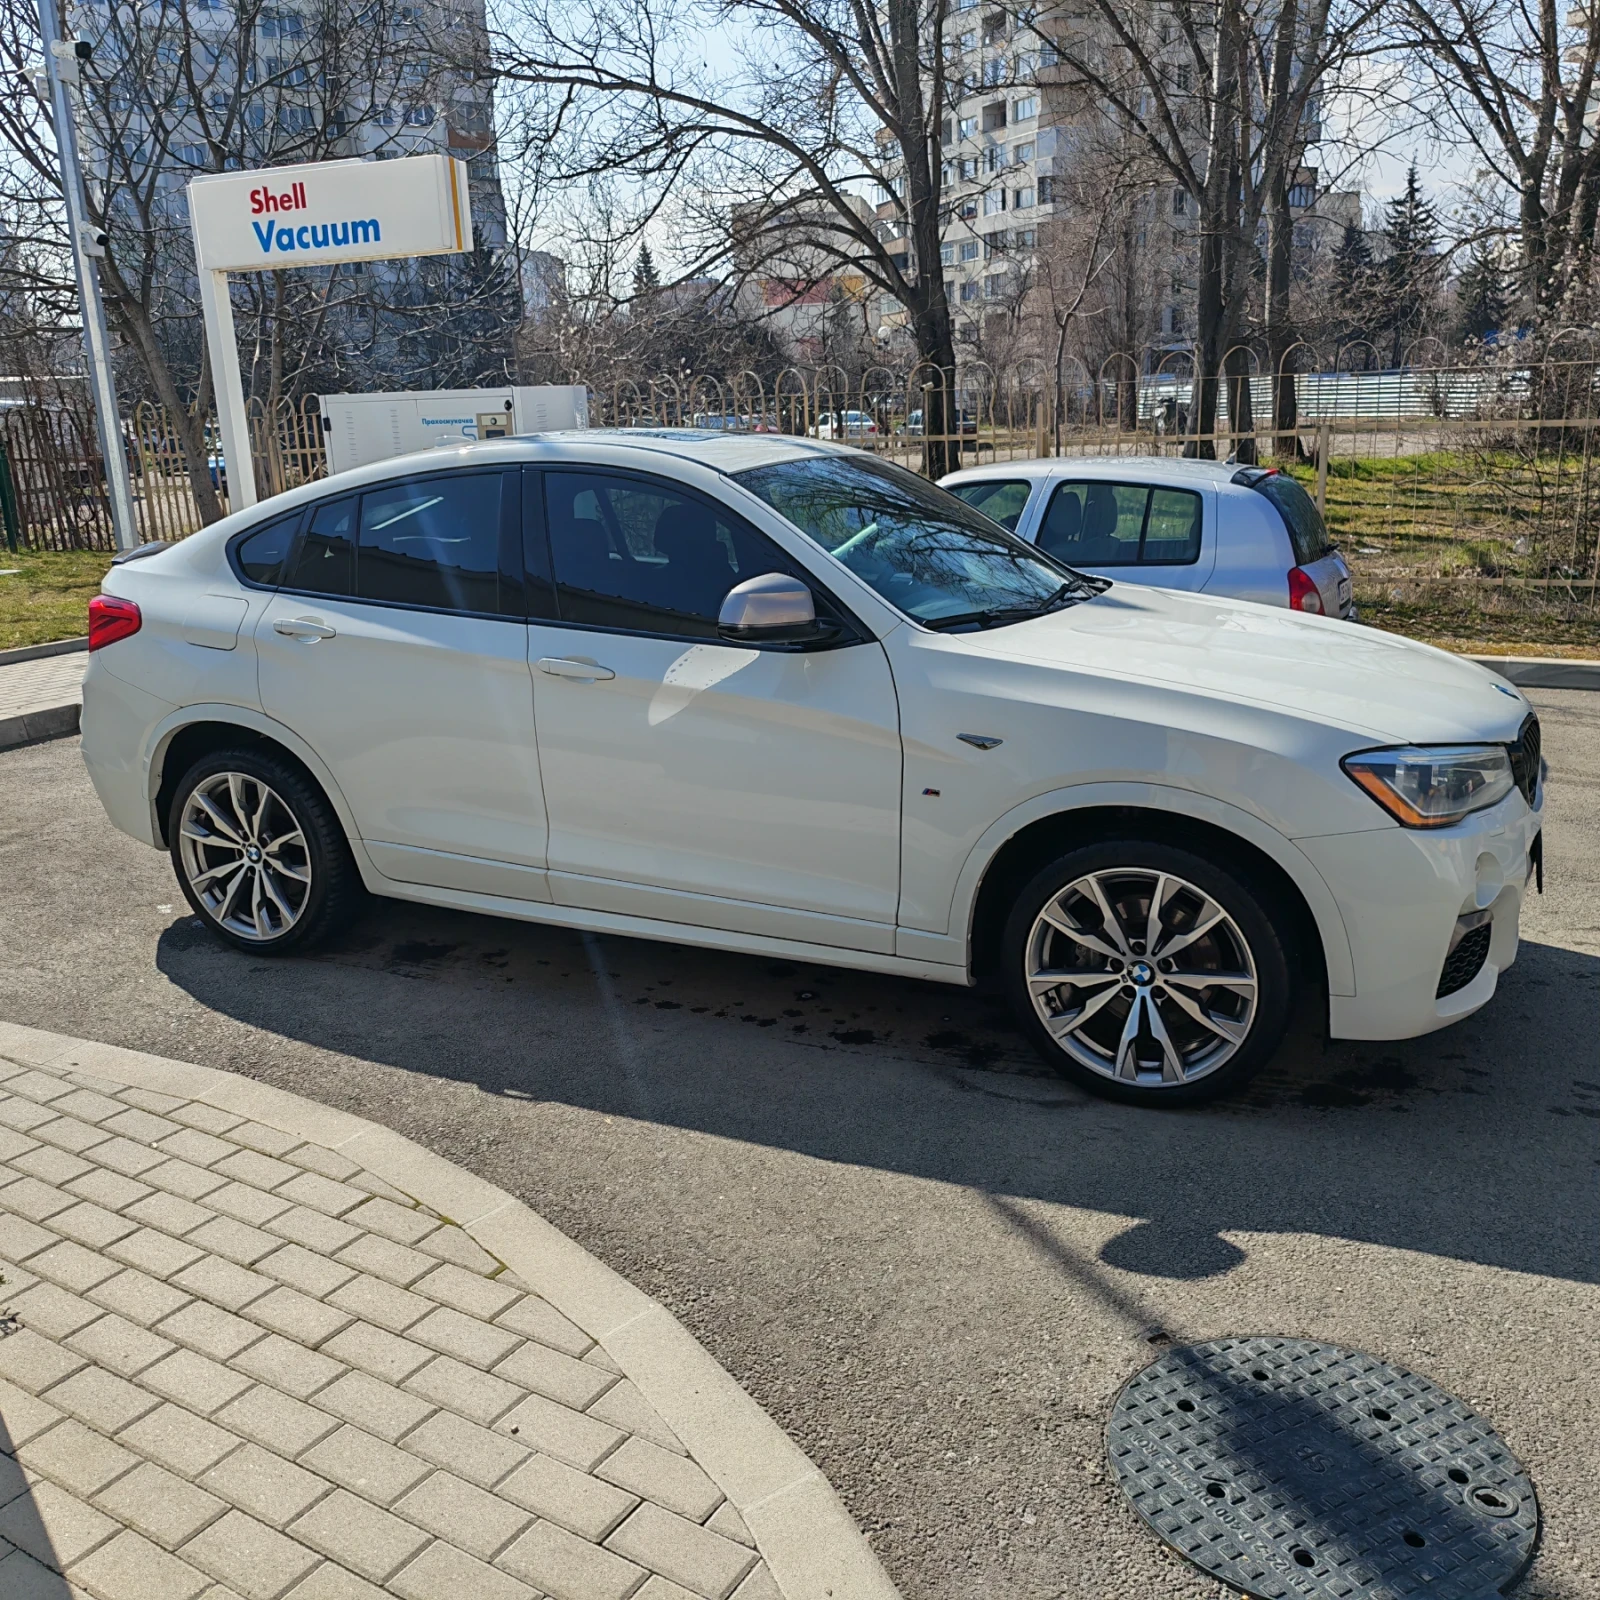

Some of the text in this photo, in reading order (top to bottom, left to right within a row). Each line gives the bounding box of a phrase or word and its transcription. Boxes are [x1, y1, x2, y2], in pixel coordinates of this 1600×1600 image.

[250, 182, 306, 213] Shell
[252, 218, 380, 252] Vacuum
[421, 417, 474, 426] Прахосмукачка
[1127, 1432, 1161, 1457] IRON
